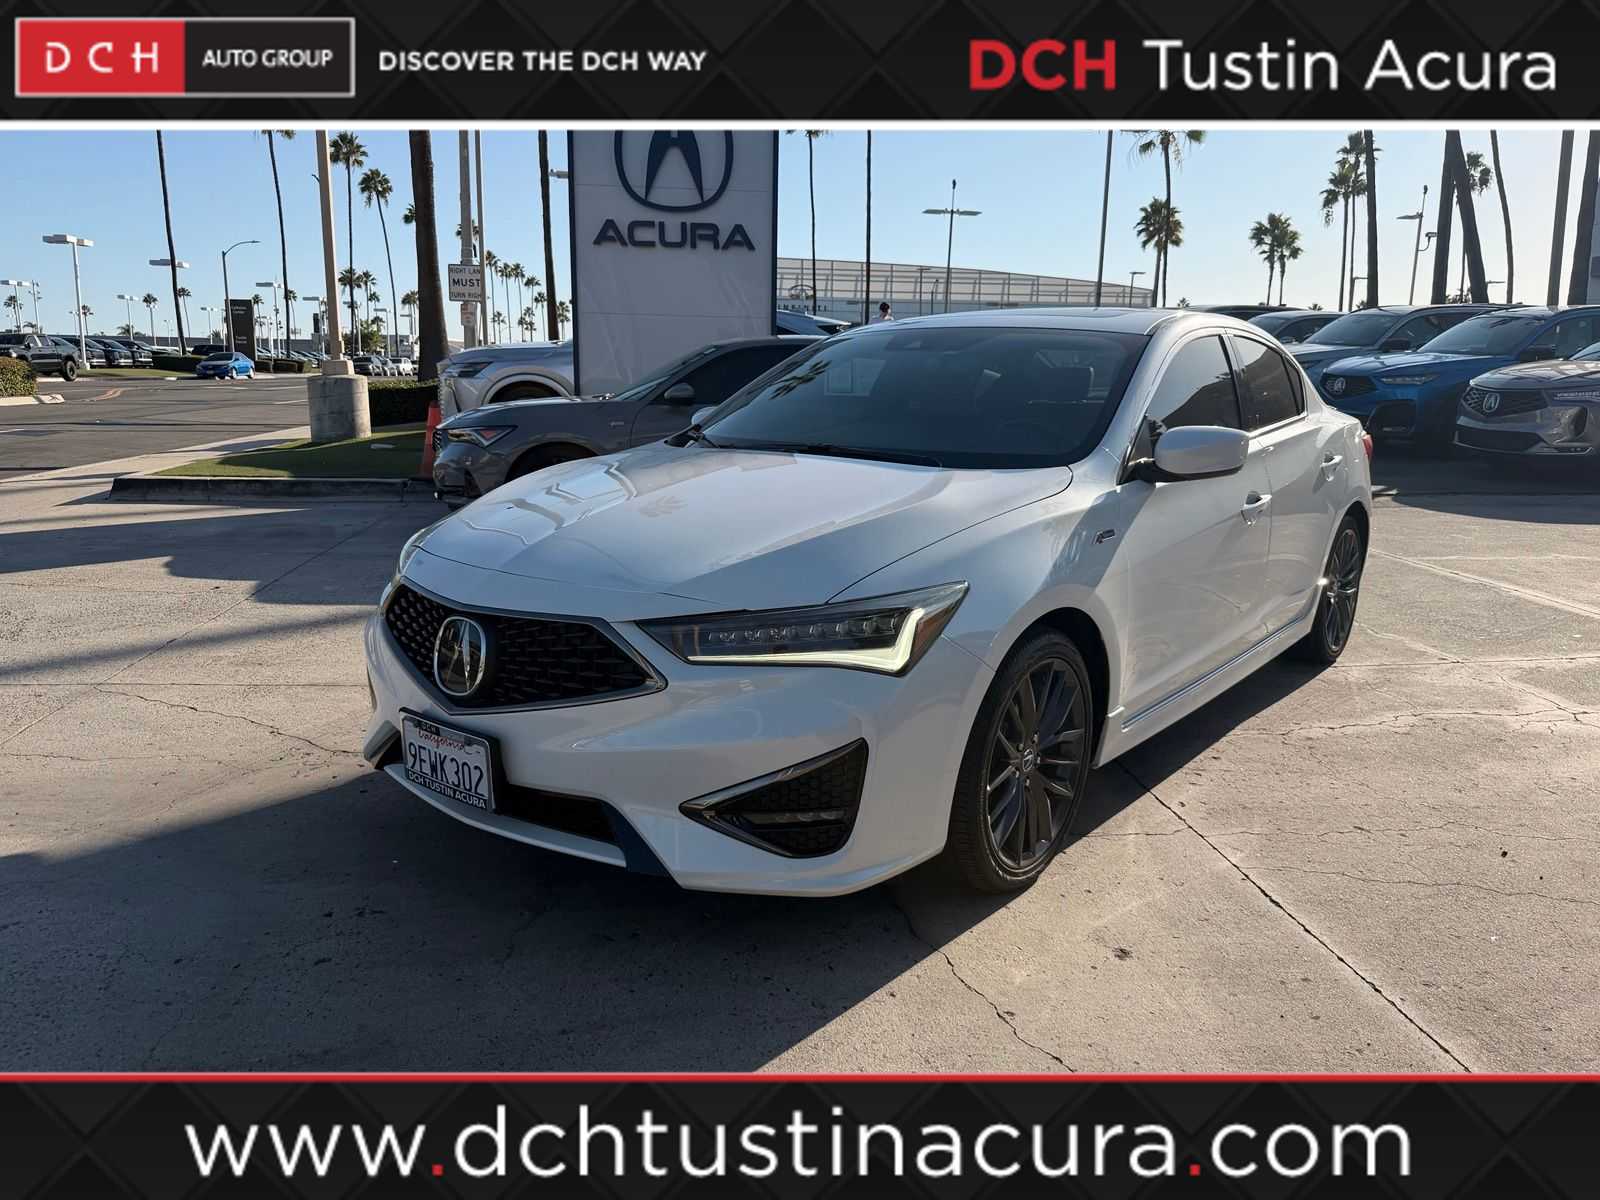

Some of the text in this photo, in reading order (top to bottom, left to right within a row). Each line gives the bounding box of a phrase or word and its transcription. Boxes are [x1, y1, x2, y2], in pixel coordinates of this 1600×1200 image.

[592, 218, 756, 252] ACURA
[452, 278, 481, 287] MUST
[408, 742, 485, 797] 9EWK302
[408, 771, 486, 809] DCH TUSTIN ACURA
